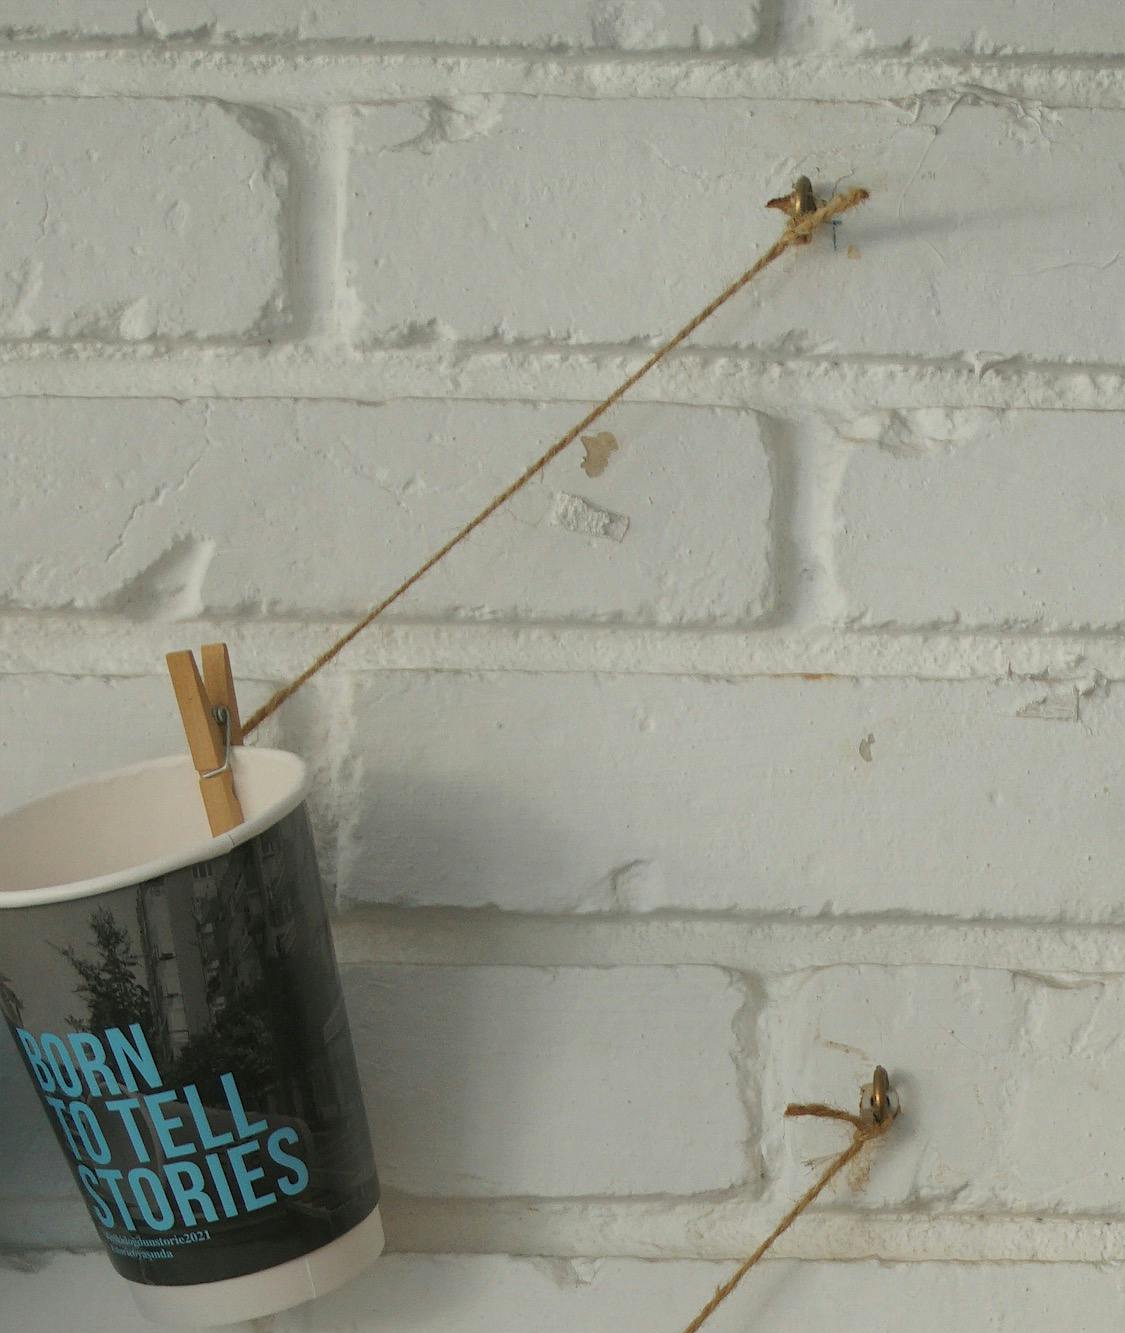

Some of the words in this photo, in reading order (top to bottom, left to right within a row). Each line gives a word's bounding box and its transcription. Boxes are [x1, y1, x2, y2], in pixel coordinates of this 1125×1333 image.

[16, 1023, 163, 1097] BORN
[46, 1095, 112, 1166] TO
[106, 1072, 269, 1164] TELL
[77, 1126, 310, 1233] STORIES
